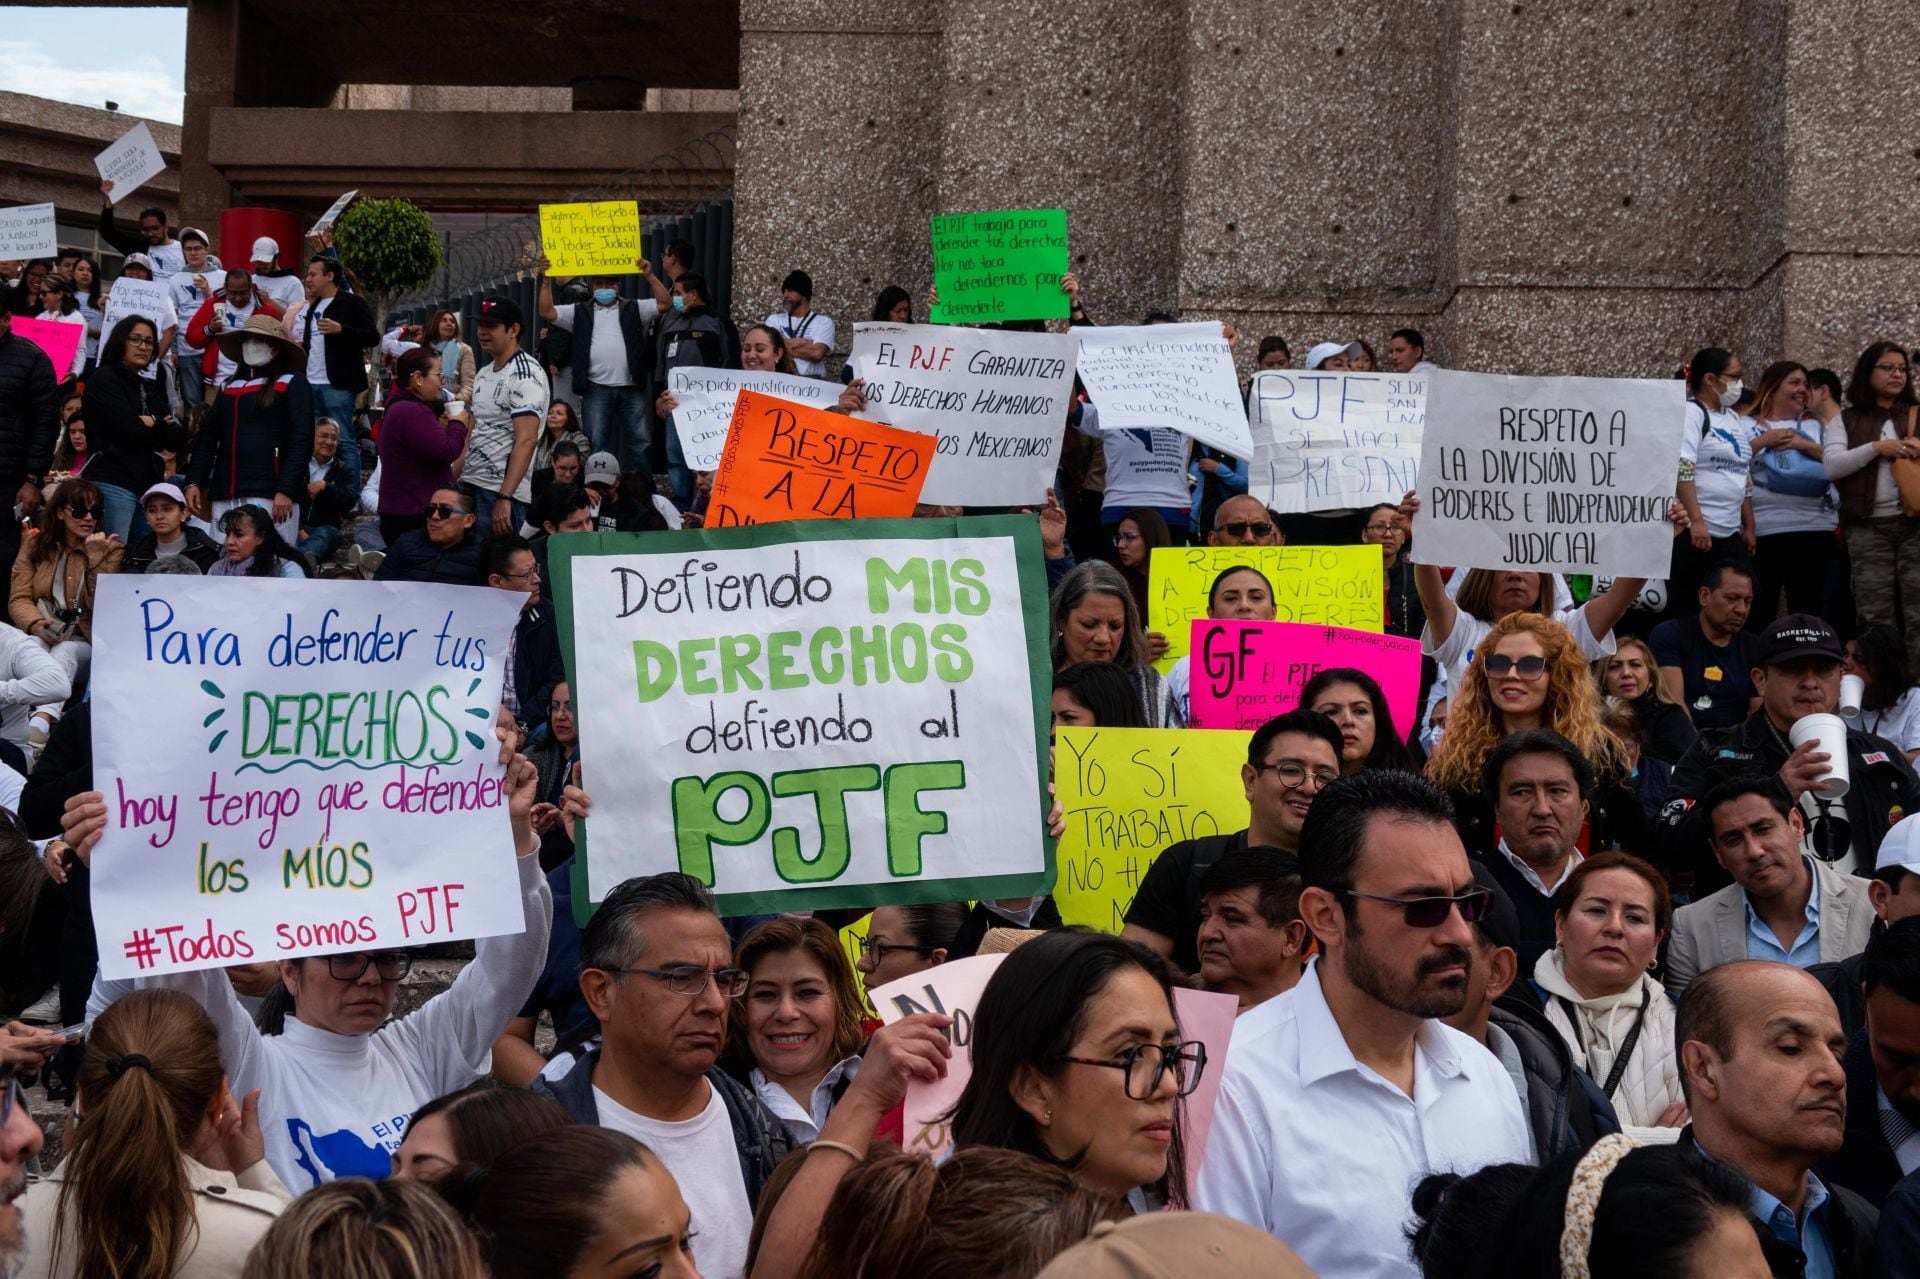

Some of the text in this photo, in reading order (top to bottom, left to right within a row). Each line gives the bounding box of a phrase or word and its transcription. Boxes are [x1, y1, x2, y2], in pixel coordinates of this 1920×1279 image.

[551, 219, 637, 237] la Independencia
[560, 236, 595, 251] Poder
[600, 235, 635, 250] Judicial
[935, 234, 1066, 251] defender tus derechos
[950, 216, 967, 234] PJF
[972, 216, 1014, 235] trabaja
[1019, 218, 1047, 234] para
[556, 252, 569, 267] de
[575, 252, 584, 267] la
[936, 254, 1004, 272] Hoy nos toca
[954, 272, 1028, 292] defendernos
[942, 296, 1005, 317] defenderte
[968, 350, 1066, 379] GARANTIZA
[676, 372, 736, 394] Despido
[888, 380, 967, 413] DERECHOS
[971, 389, 1053, 416] HUMANOS
[1256, 373, 1380, 424] PJF
[764, 408, 919, 481] RESPETO
[966, 431, 1053, 458] MEXICANOS
[1500, 407, 1626, 447] RESPETO A
[1440, 446, 1616, 488] LA DIVISIÓN DE
[764, 470, 857, 518] A LA
[1432, 487, 1514, 522] PODERES
[1524, 493, 1535, 523] E
[1503, 532, 1600, 565] JUDICIAL
[611, 550, 991, 618] Defiendo MIS
[1162, 577, 1178, 600] A
[141, 597, 487, 672] Para defender tus
[633, 623, 974, 703] DERECHOS
[1236, 692, 1268, 706] para
[241, 684, 461, 763] DERECHOS
[685, 688, 960, 754] defiendo al
[116, 764, 507, 849] hoy tengo que defender
[672, 759, 966, 888] PJF
[196, 832, 375, 896] los MÍOS
[1068, 850, 1104, 894] NO
[124, 884, 465, 970] #Todos somos PJF
[371, 1121, 393, 1138] El
